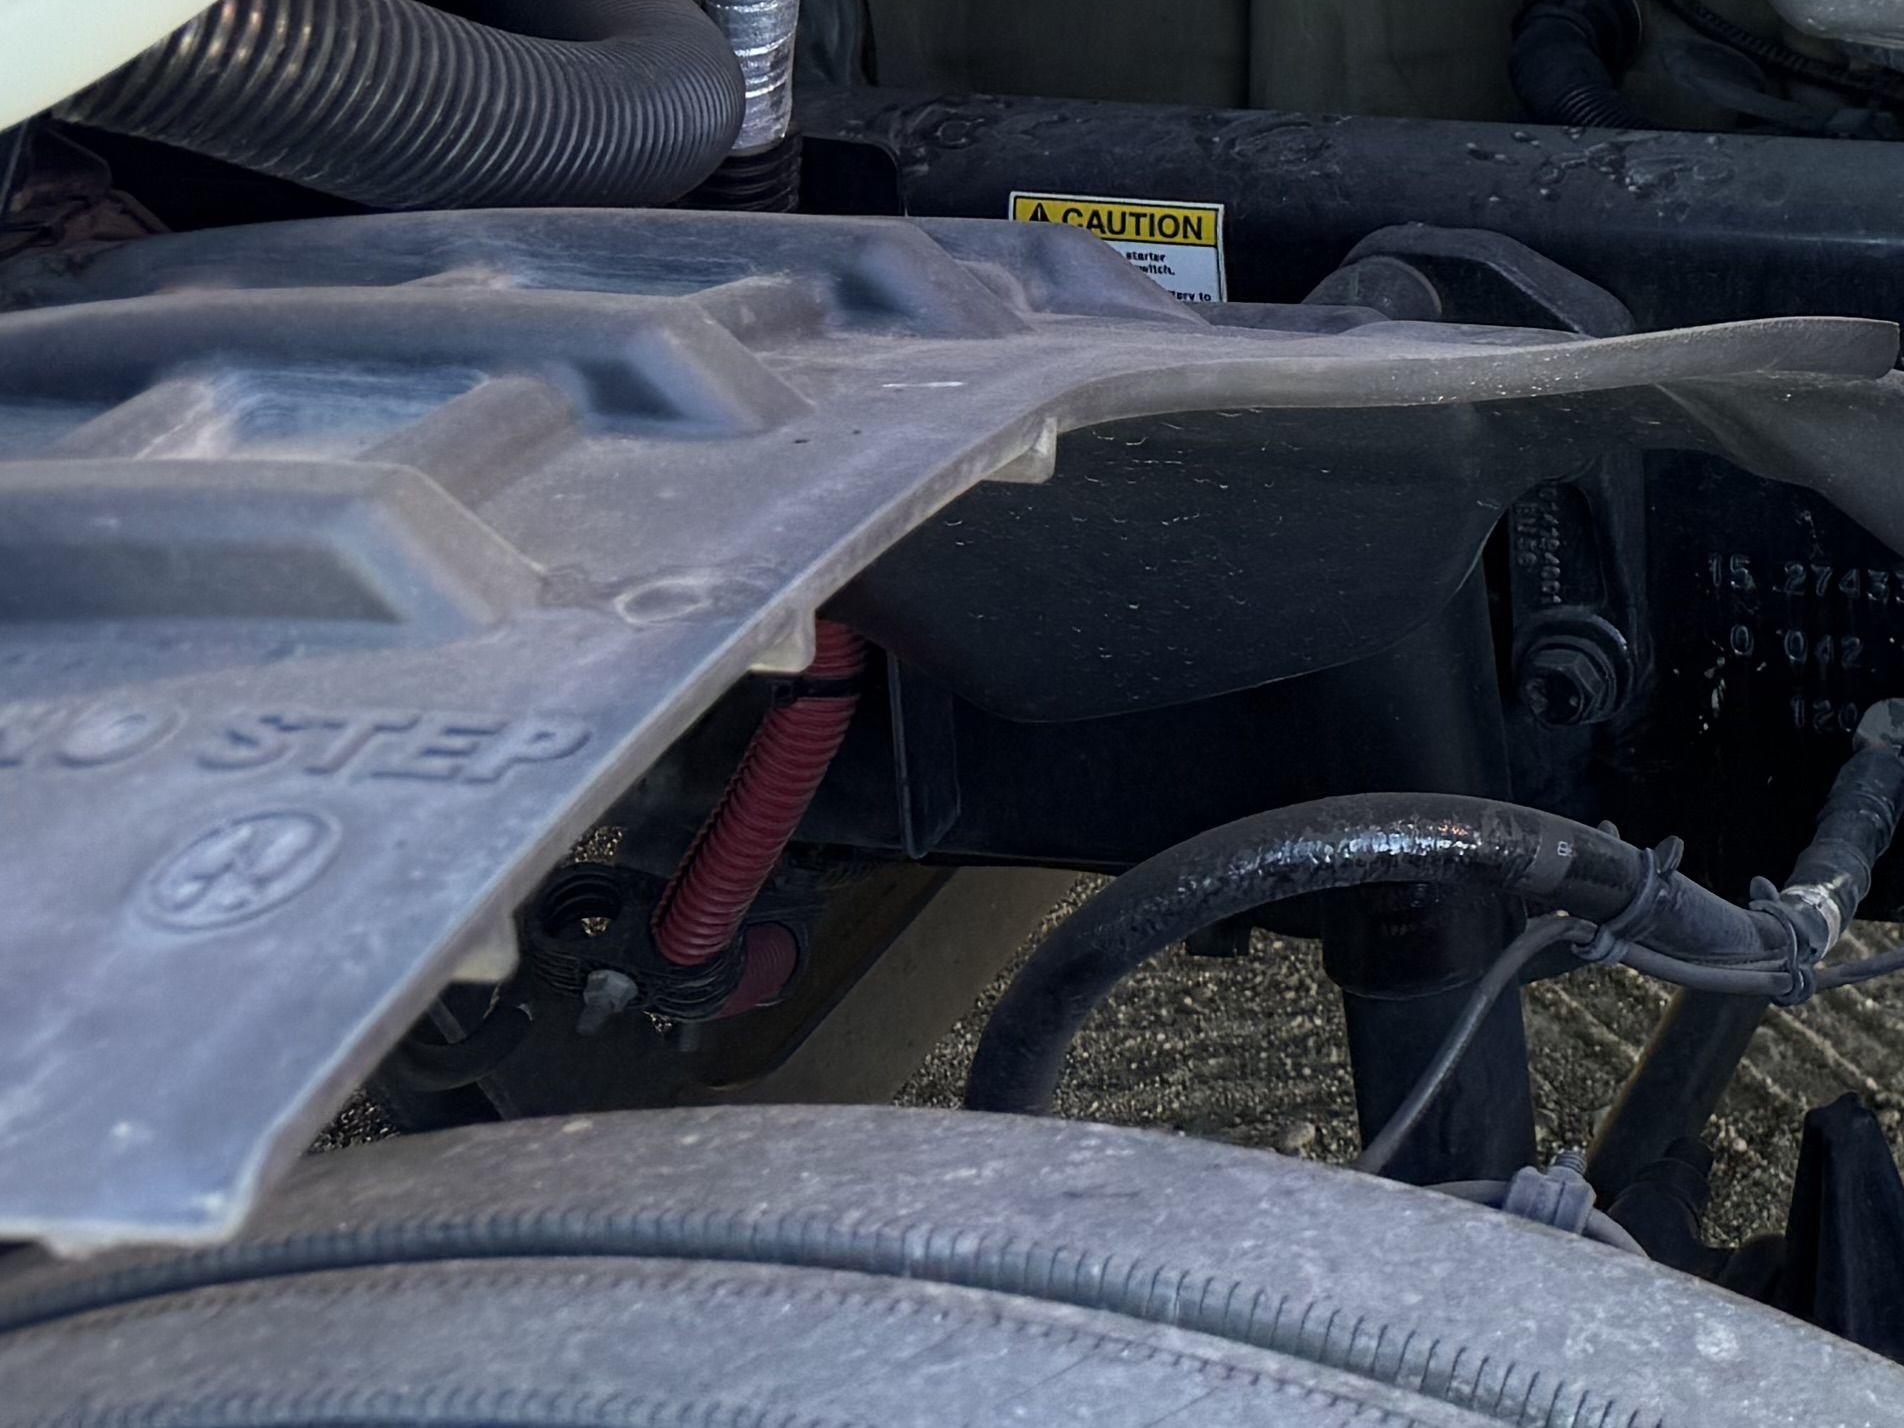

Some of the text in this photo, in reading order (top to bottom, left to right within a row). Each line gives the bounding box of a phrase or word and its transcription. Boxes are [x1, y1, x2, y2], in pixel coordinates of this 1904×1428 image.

[1062, 207, 1203, 241] CAUTION
[1126, 251, 1166, 263] starter
[1199, 292, 1211, 302] to
[196, 711, 592, 785] STEP
